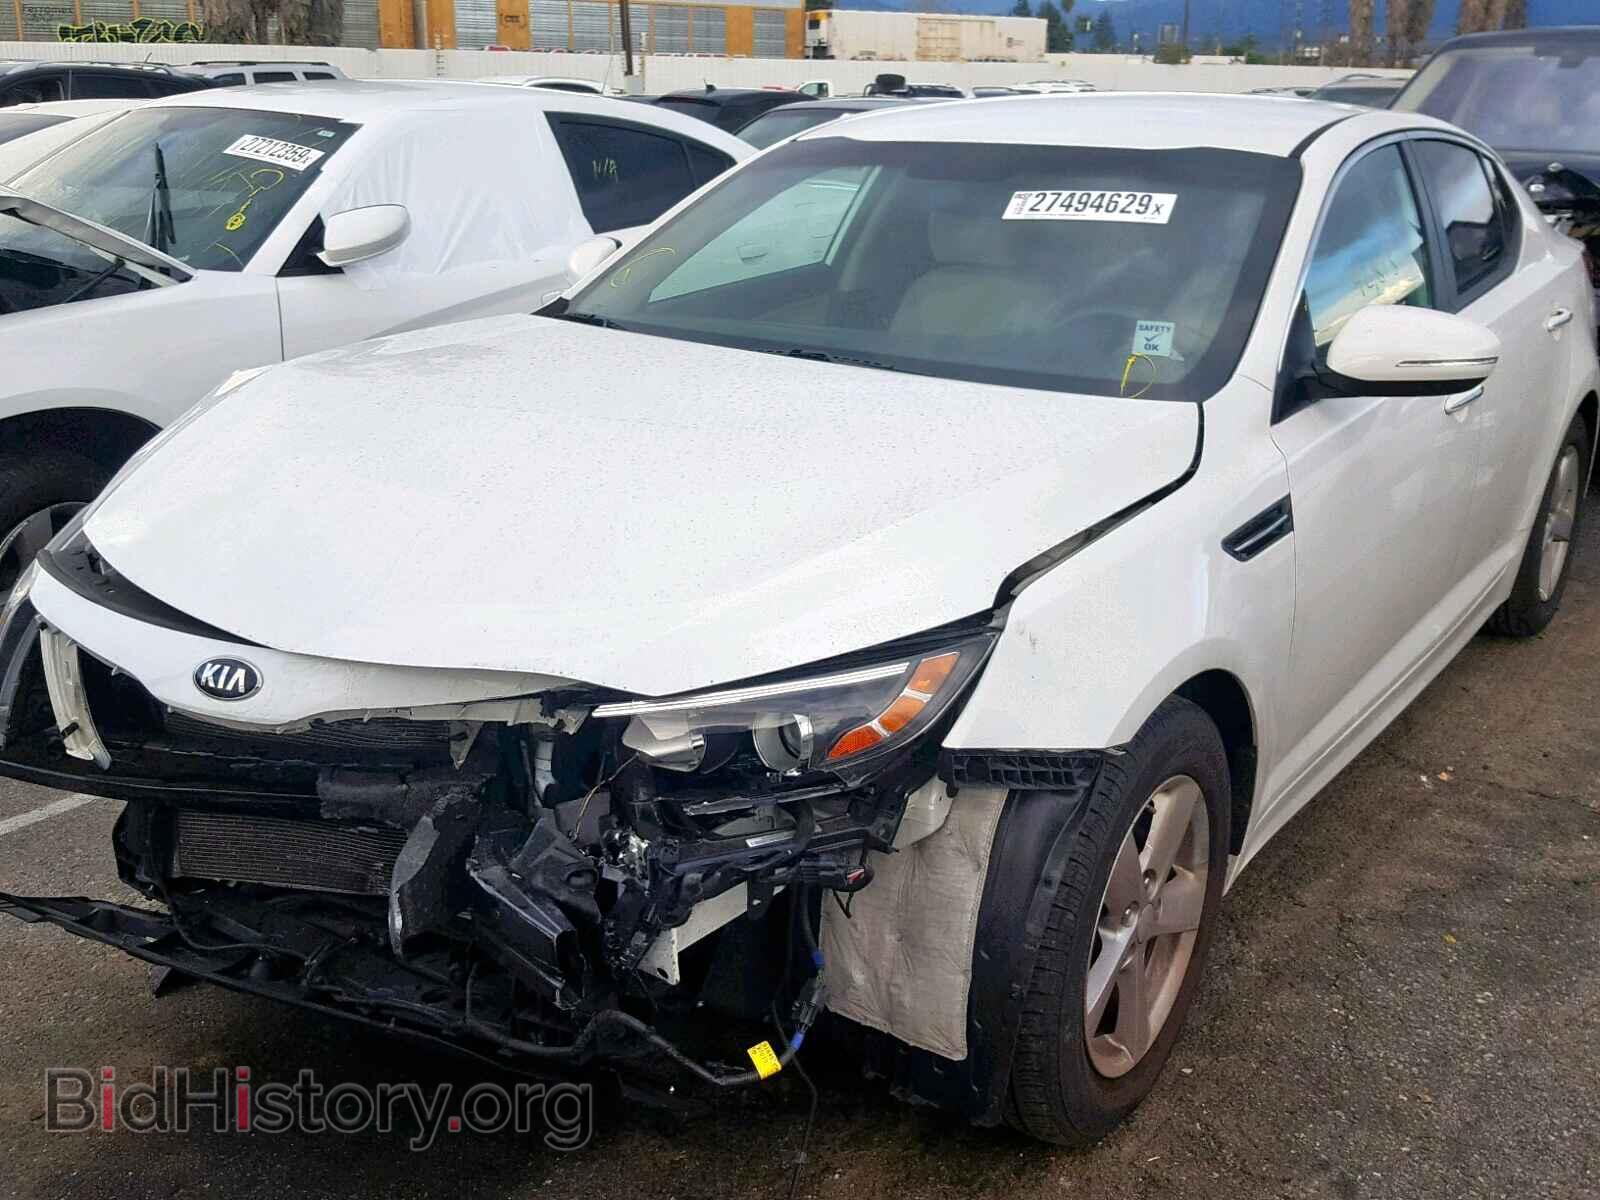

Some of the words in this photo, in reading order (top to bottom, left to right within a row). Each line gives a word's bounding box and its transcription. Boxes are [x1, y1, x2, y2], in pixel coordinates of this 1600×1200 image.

[1138, 324, 1171, 333] SAFETY
[1143, 343, 1160, 352] OK
[200, 662, 246, 693] KIA
